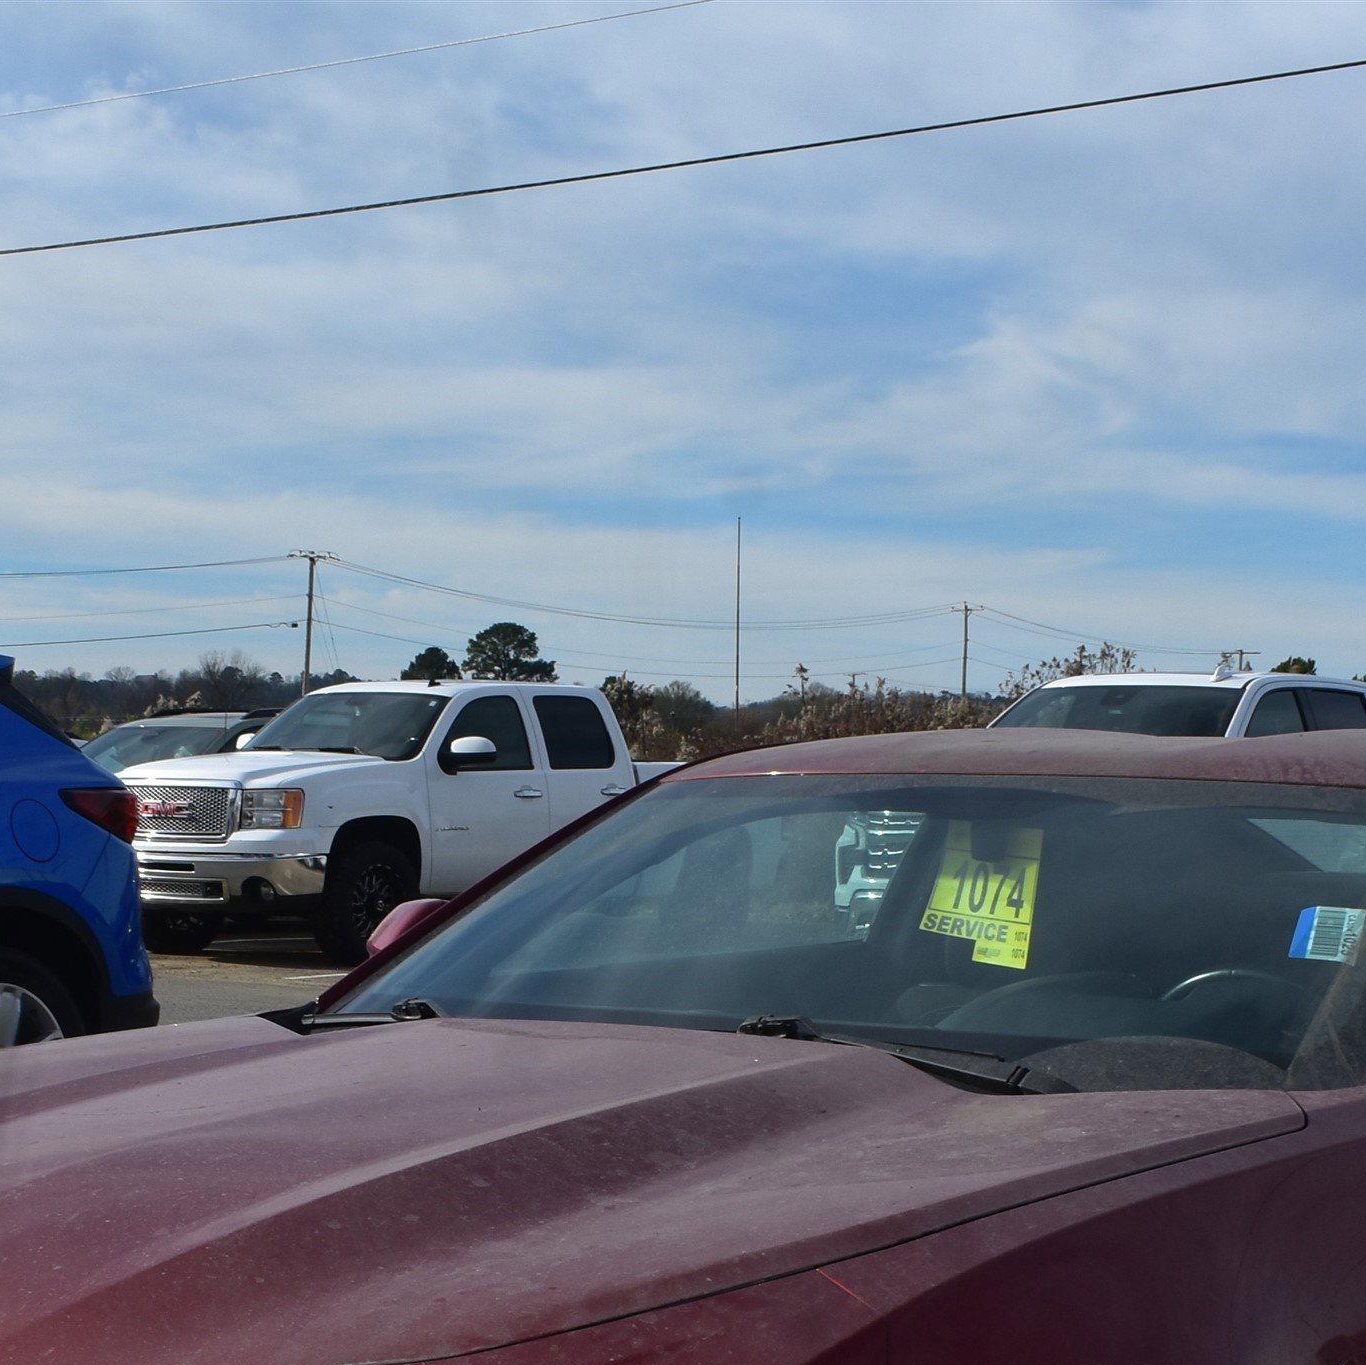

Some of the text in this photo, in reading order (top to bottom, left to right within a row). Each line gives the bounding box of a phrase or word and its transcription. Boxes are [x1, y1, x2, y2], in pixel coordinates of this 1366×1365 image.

[141, 801, 192, 818] GMC
[952, 860, 1027, 918] 1074
[923, 913, 1009, 943] SERVICE
